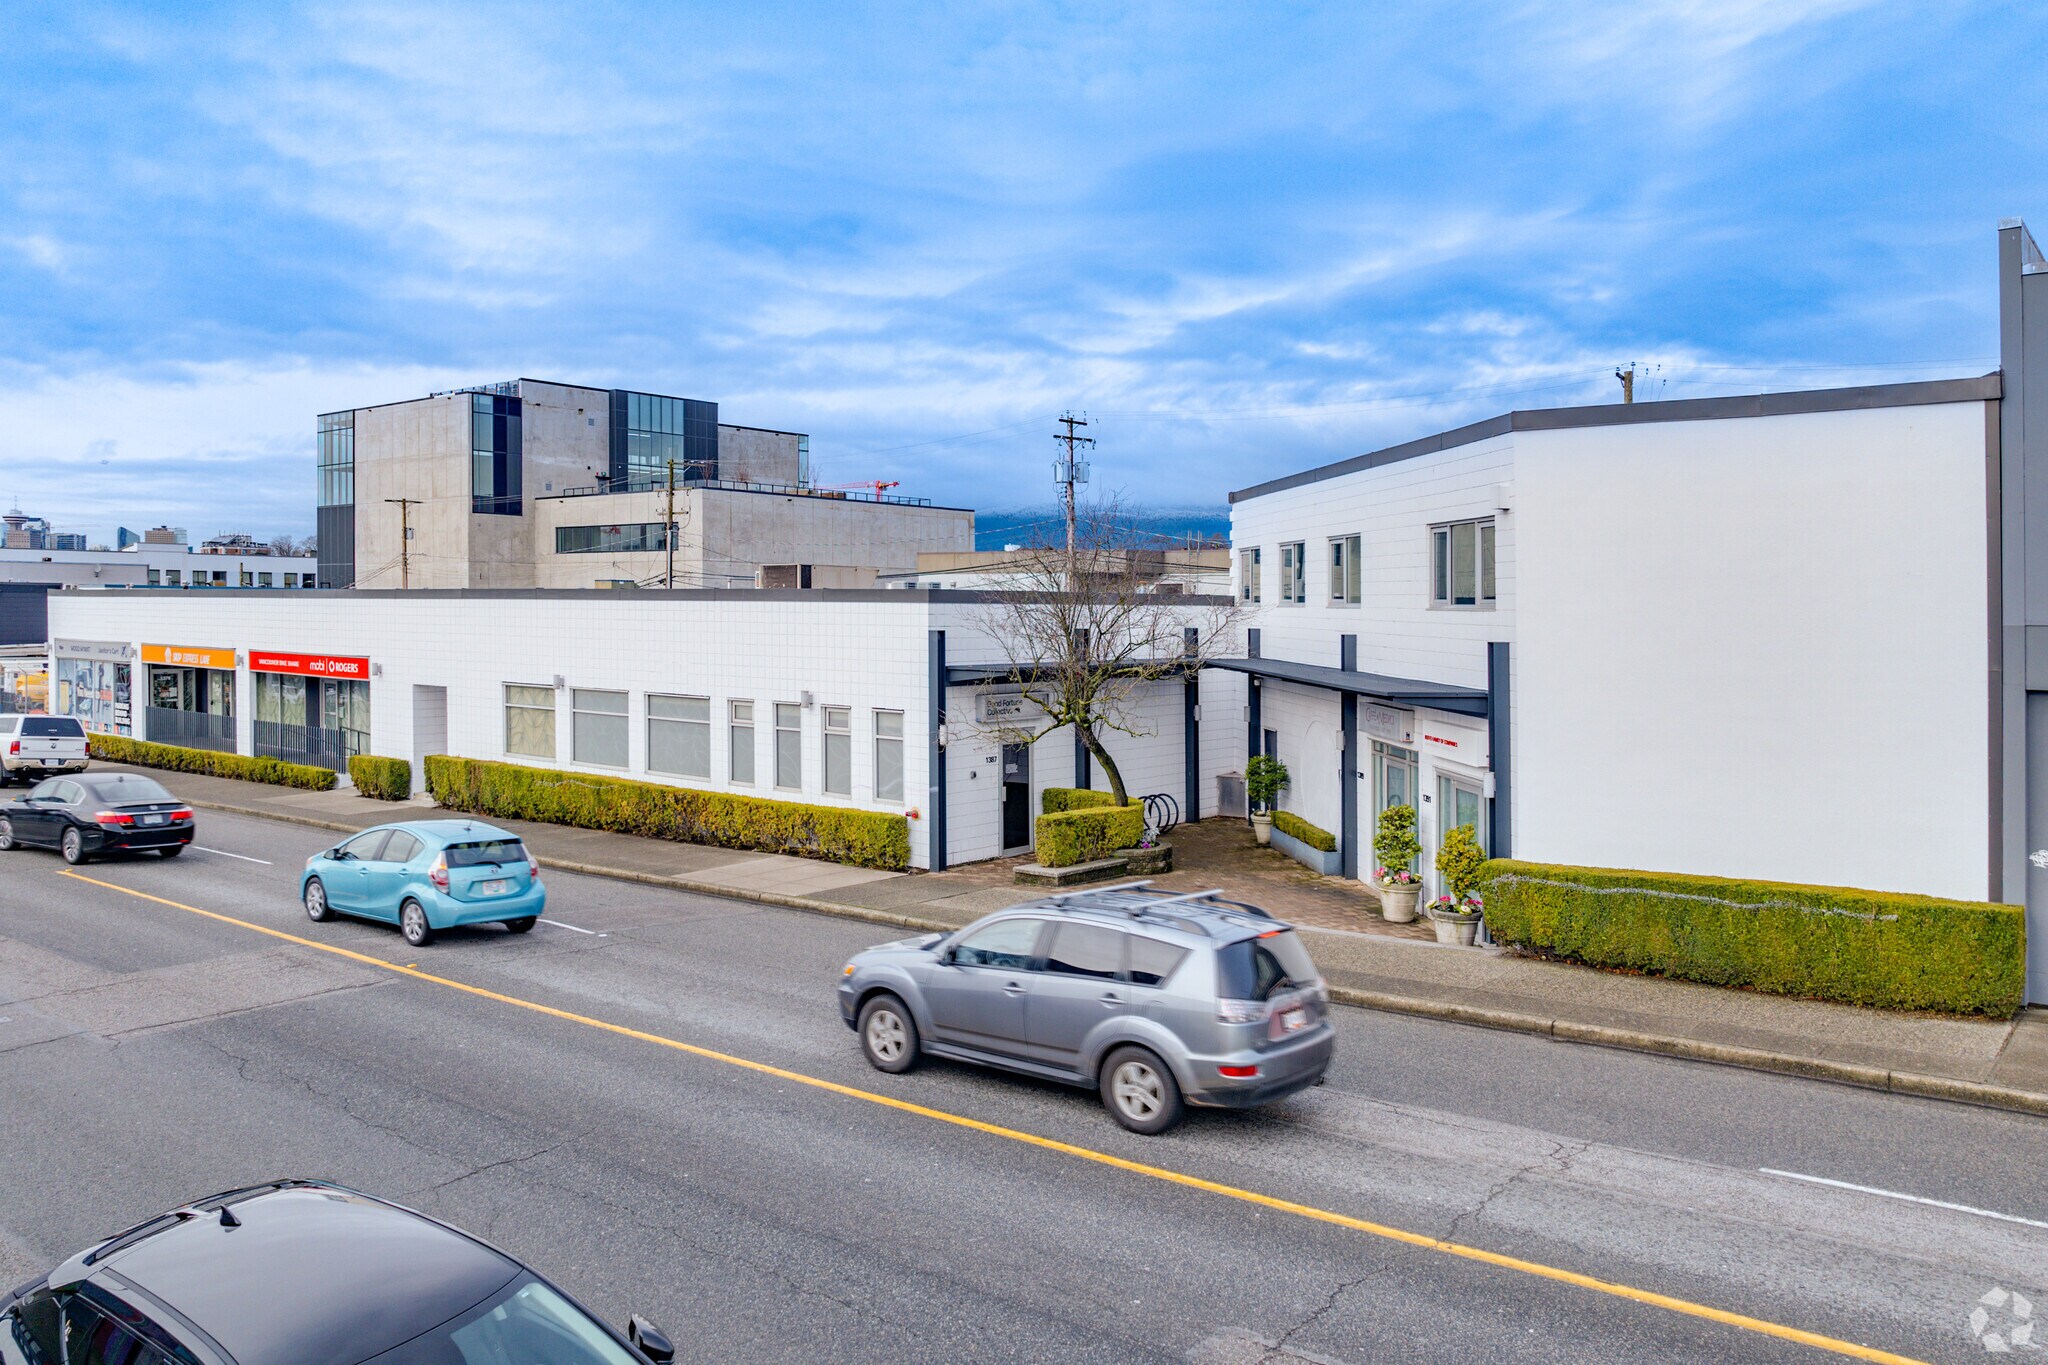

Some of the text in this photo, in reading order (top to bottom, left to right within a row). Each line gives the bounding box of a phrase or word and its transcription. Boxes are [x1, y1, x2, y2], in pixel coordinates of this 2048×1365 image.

[182, 653, 199, 664] EXPRESS
[200, 654, 211, 665] LANE
[310, 660, 325, 671] mobi
[336, 662, 358, 673] ROGERS
[1002, 700, 1023, 708] Fortune
